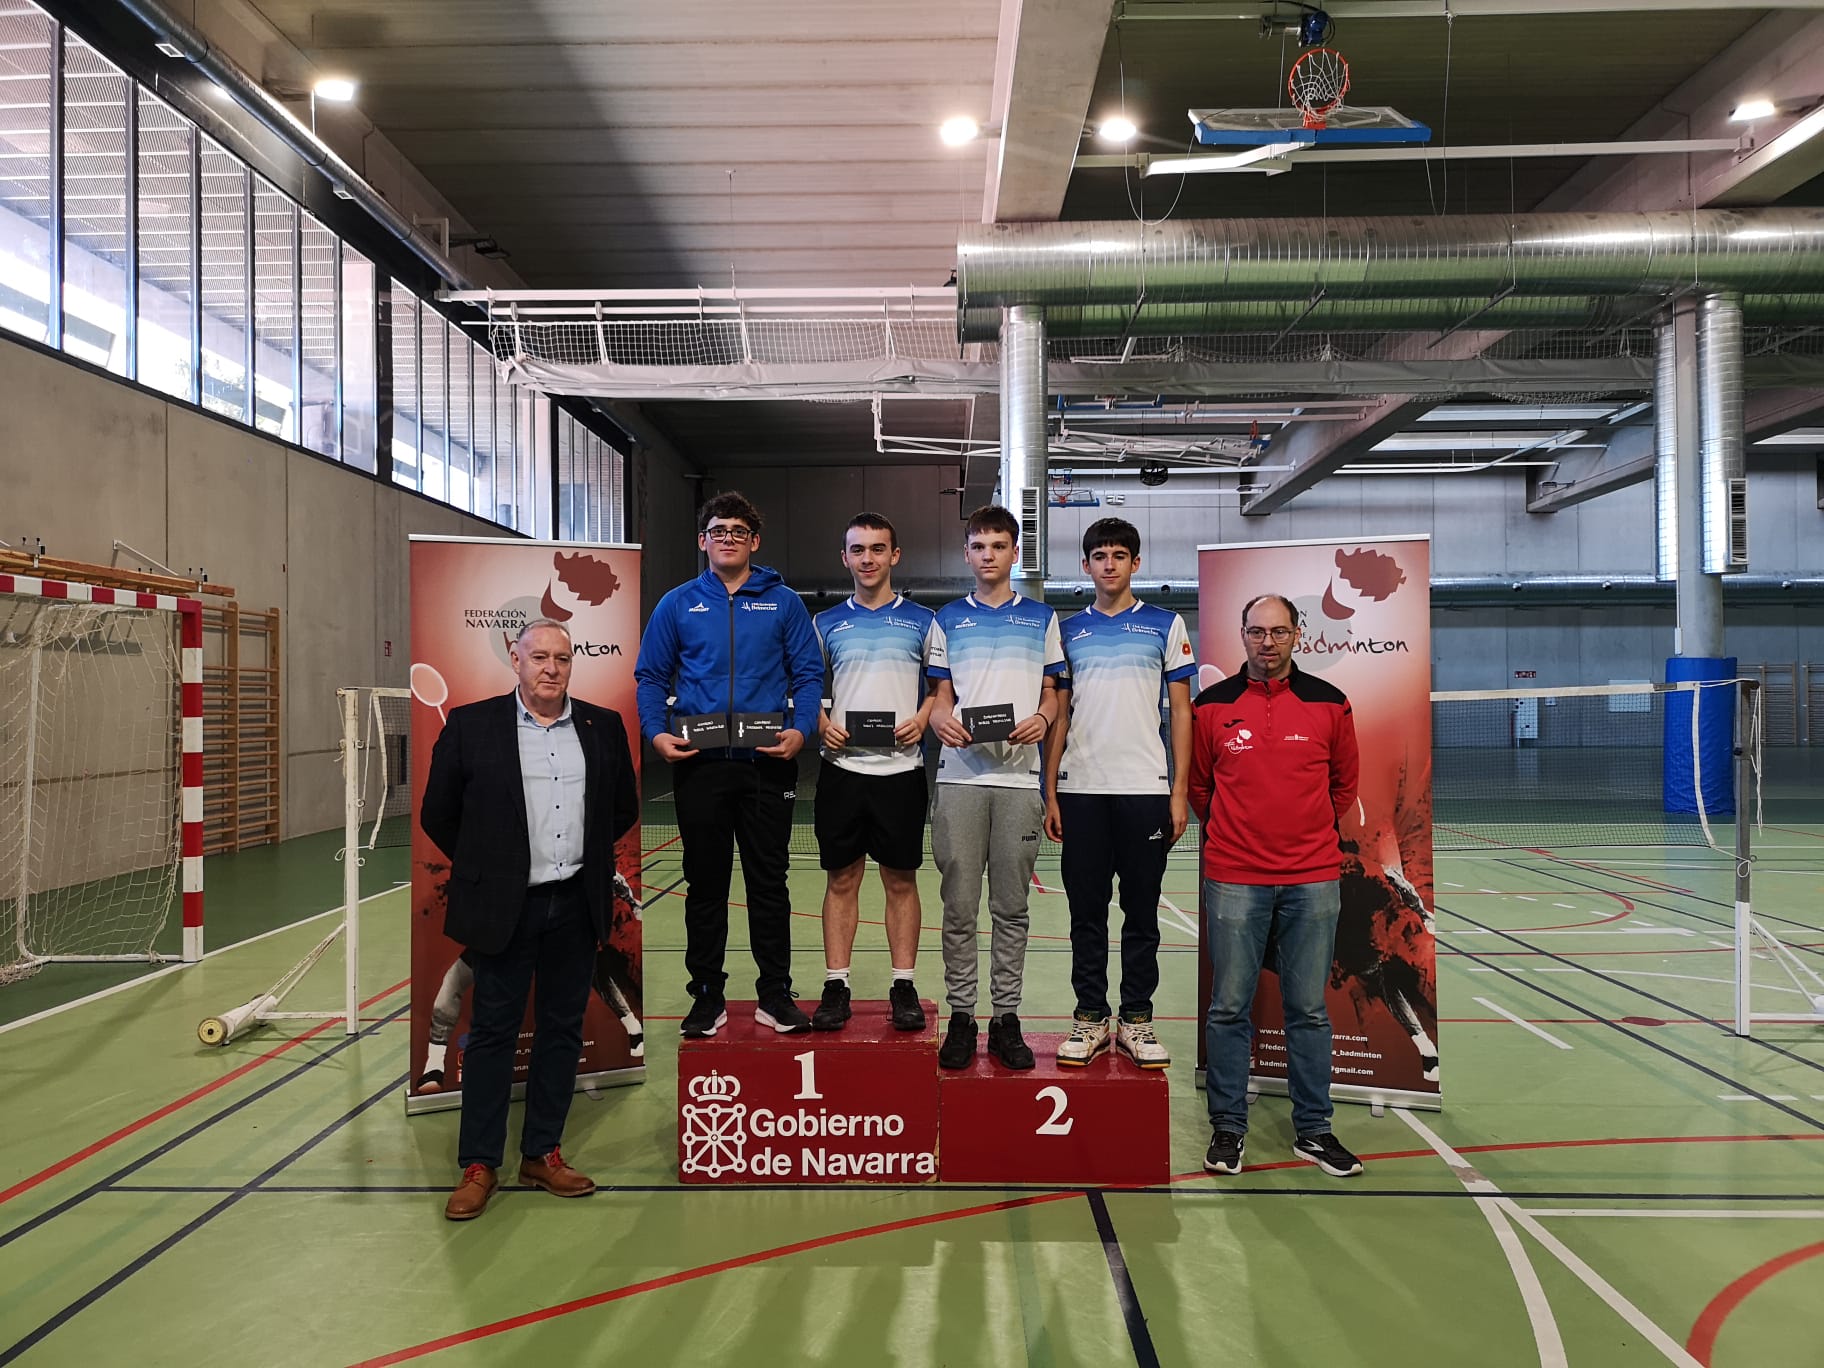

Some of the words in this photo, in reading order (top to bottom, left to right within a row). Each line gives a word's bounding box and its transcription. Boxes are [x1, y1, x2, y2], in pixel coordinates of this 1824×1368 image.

[464, 608, 527, 619] FEDERACIÓN
[465, 619, 527, 629] NAVARRA
[794, 1050, 823, 1100] 1
[749, 1108, 905, 1137] Gobierno
[1035, 1085, 1074, 1135] 2
[750, 1146, 792, 1176] de
[801, 1147, 936, 1176] Navarra
